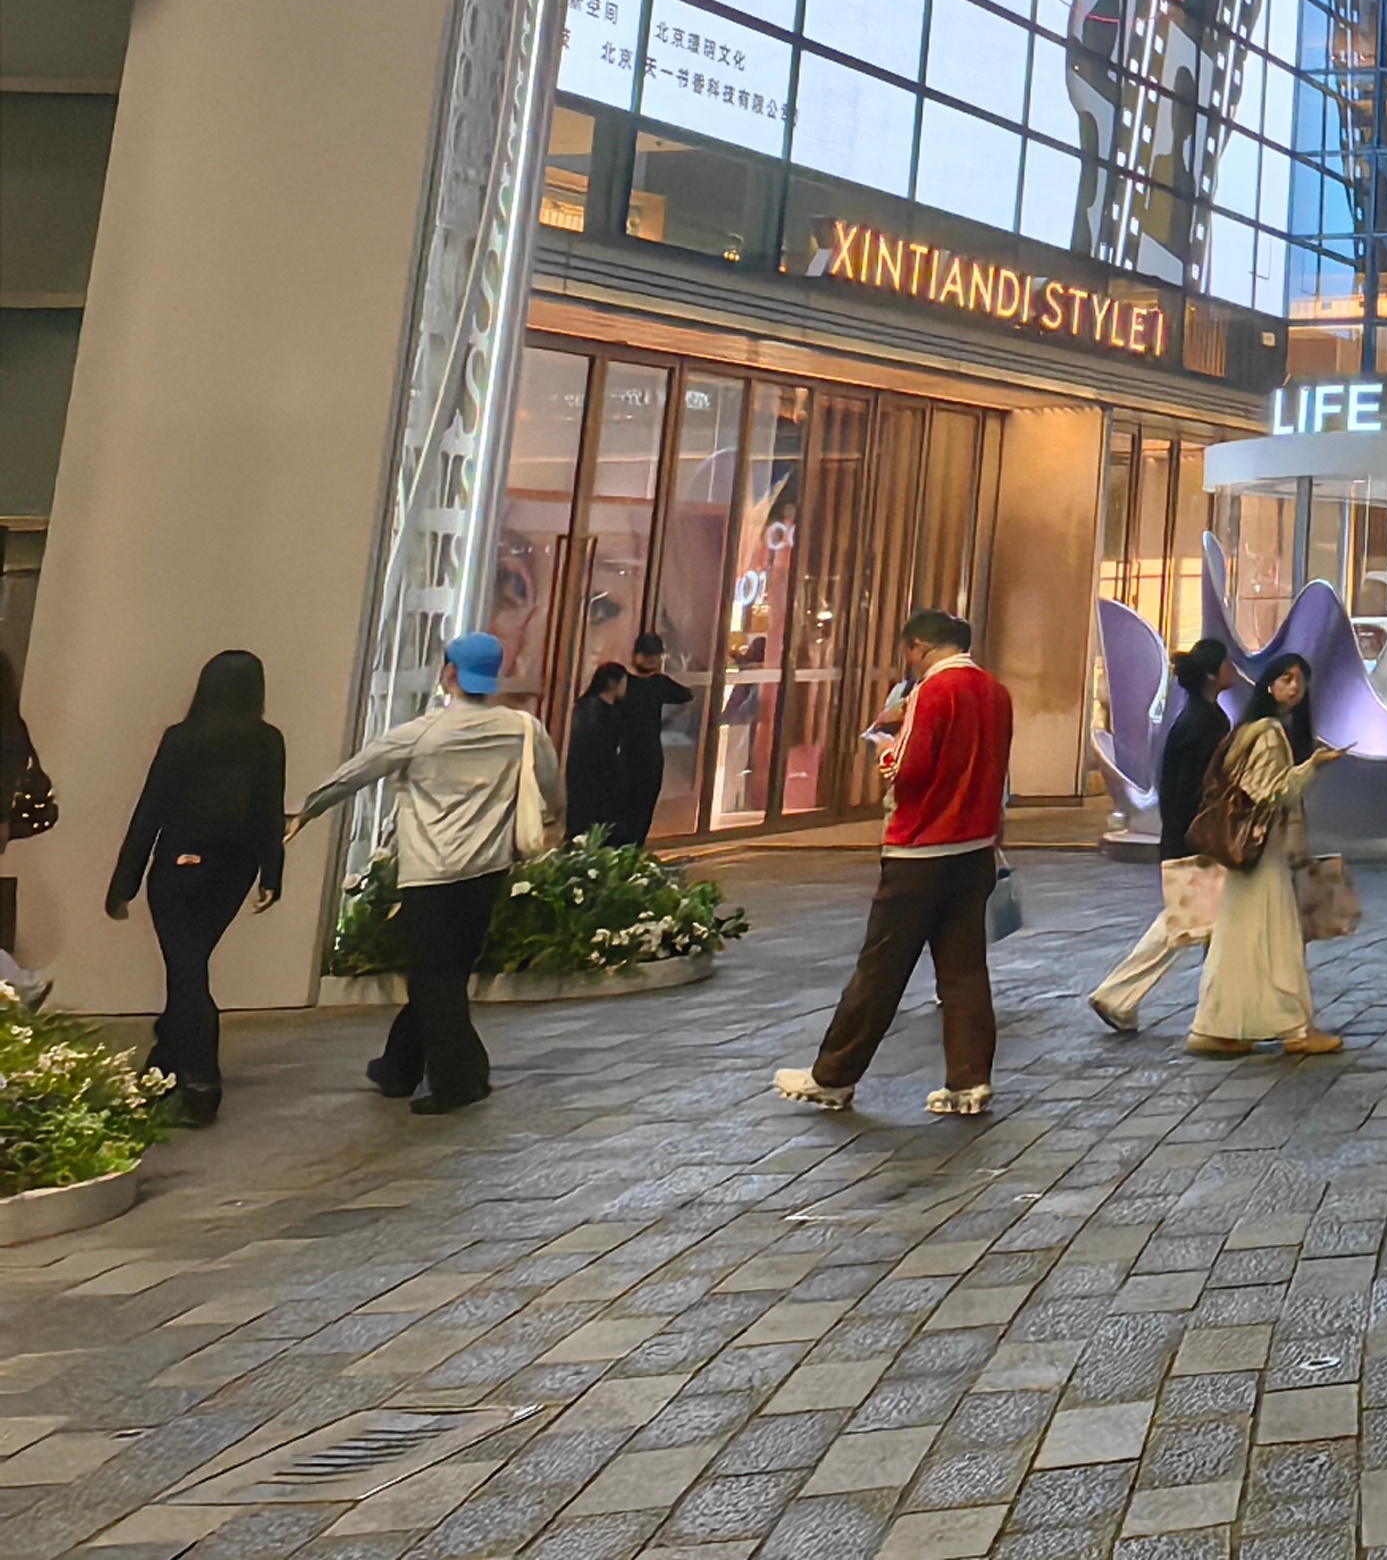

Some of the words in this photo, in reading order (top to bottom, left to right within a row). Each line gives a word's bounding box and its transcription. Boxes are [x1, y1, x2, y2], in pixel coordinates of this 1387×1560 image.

[830, 220, 1033, 324] XINTIANDI
[1042, 282, 1148, 355] STYLE
[1272, 382, 1383, 436] LIFE
